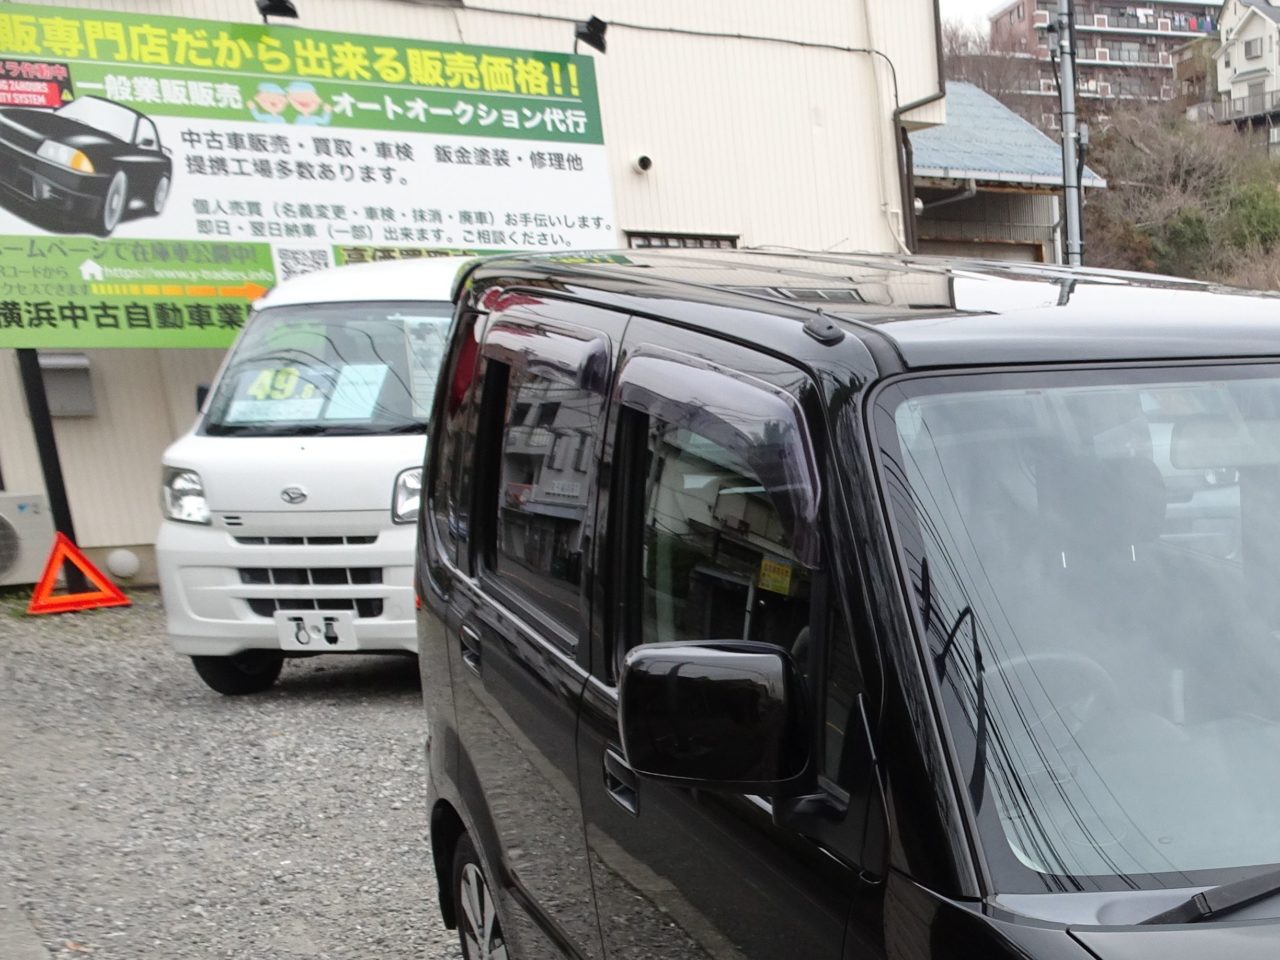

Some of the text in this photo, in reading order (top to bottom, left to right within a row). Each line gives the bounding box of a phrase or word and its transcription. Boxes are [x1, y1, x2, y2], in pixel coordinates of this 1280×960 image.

[76, 73, 243, 110] 一般業販販売
[331, 92, 588, 134] オートオークション代行
[185, 154, 408, 186] 提携工場多数あります。
[0, 300, 253, 330] 横浜中古自動車業
